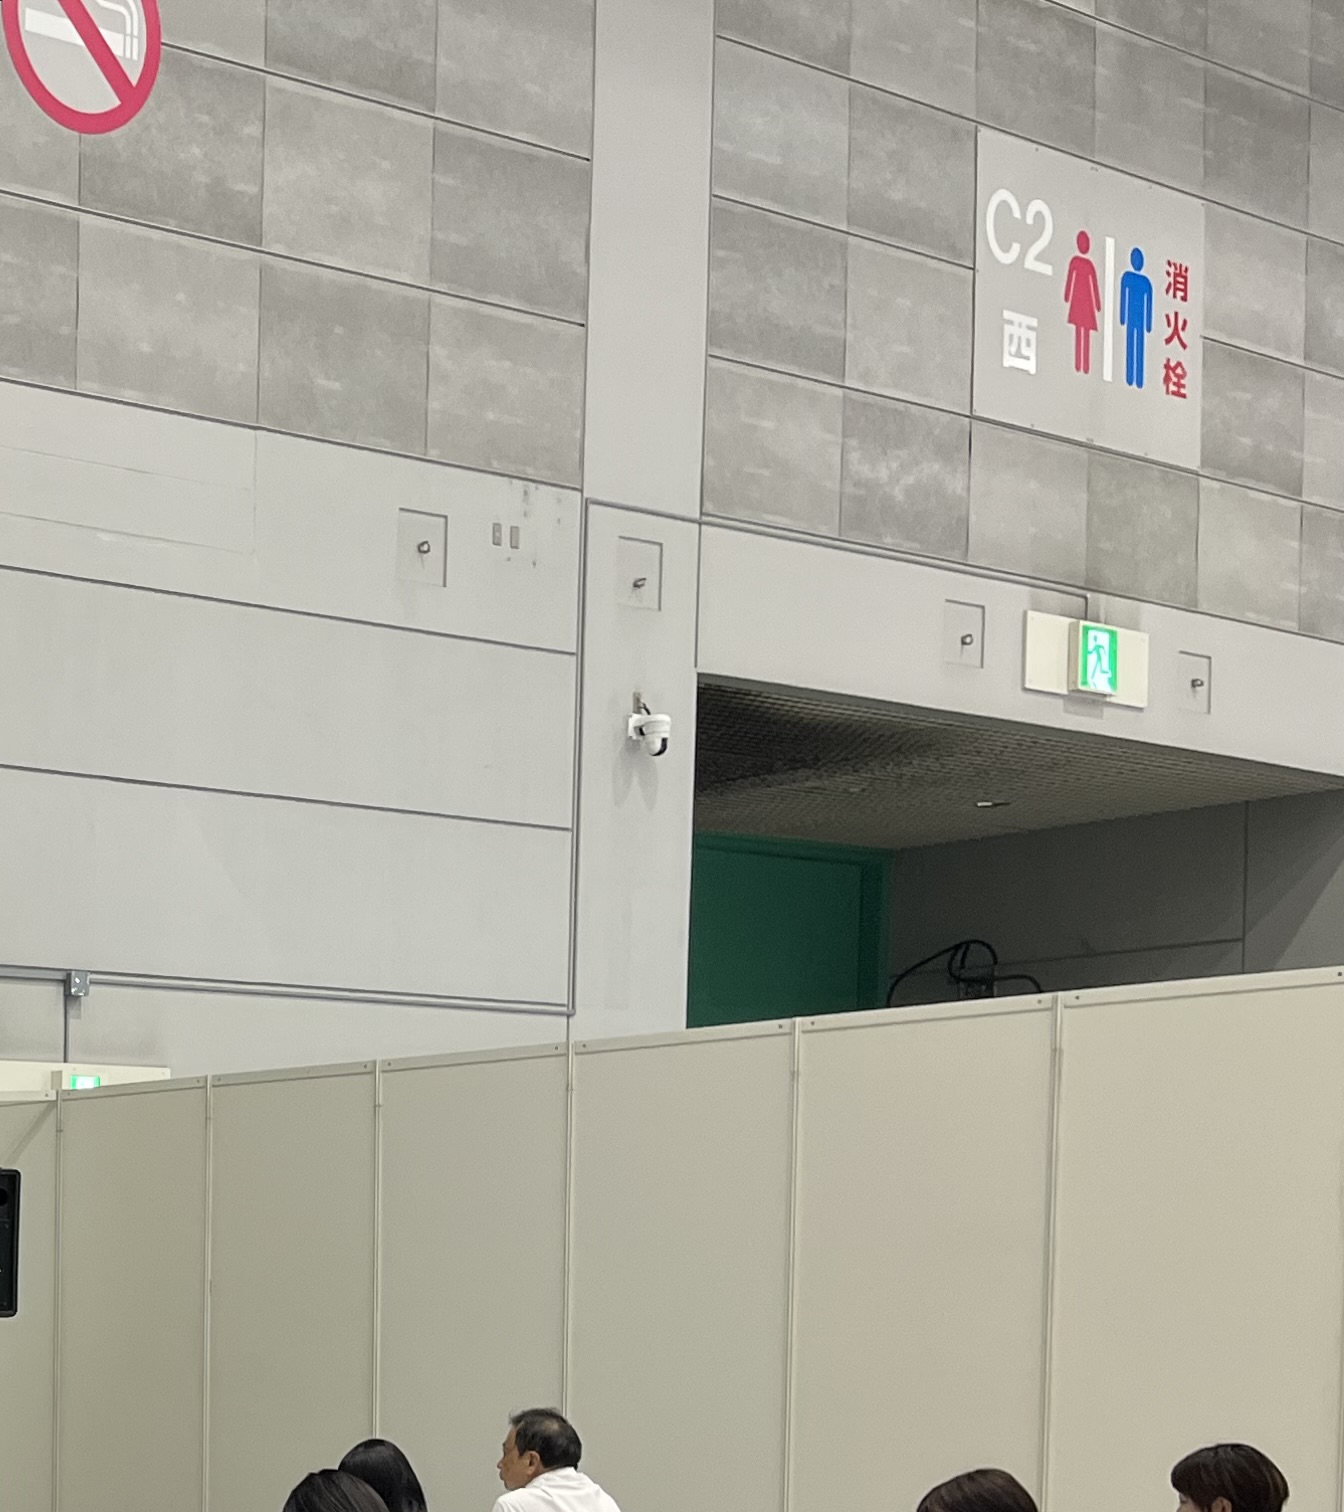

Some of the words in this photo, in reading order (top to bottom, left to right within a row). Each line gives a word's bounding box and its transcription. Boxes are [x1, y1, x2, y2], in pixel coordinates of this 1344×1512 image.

[986, 188, 1053, 276] C2
[1002, 309, 1038, 375] 西
[1163, 260, 1189, 399] 消火栓
